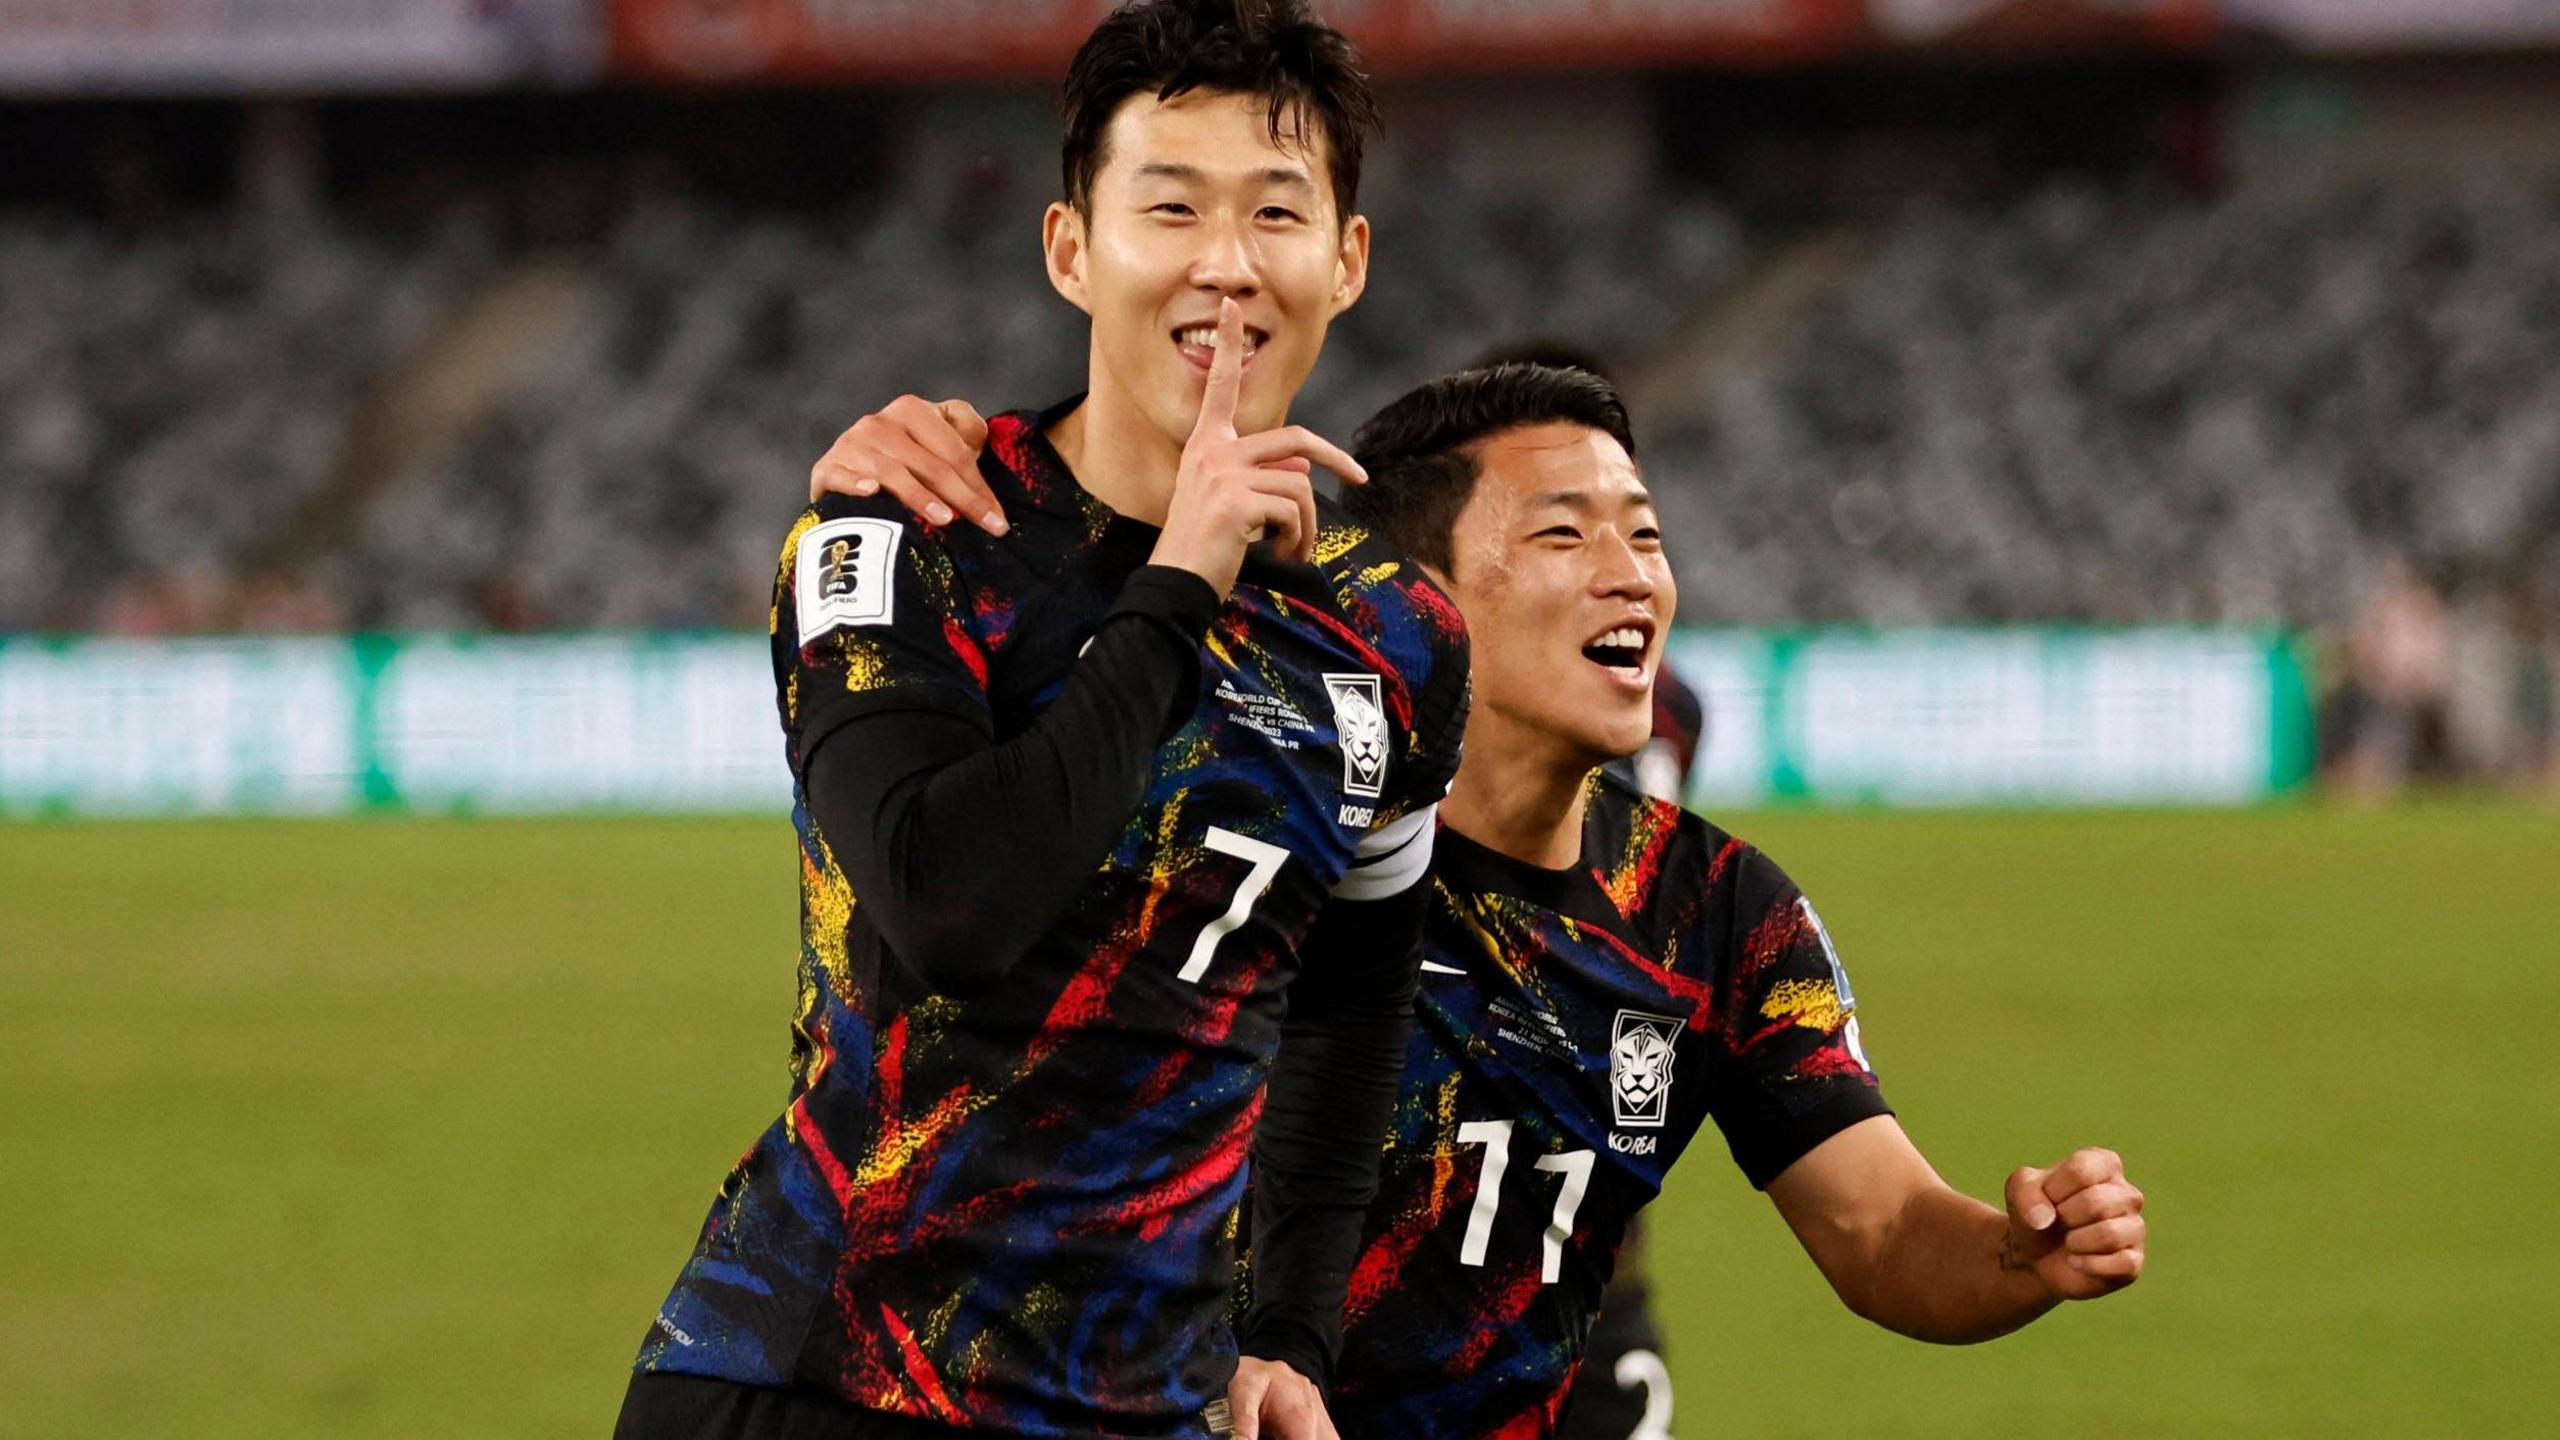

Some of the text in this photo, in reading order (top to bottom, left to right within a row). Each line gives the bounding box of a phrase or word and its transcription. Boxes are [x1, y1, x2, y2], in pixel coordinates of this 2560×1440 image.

[1177, 825, 1291, 984] 7
[1608, 1130, 1657, 1155] KOREA
[1614, 1348, 1675, 1440] 2
